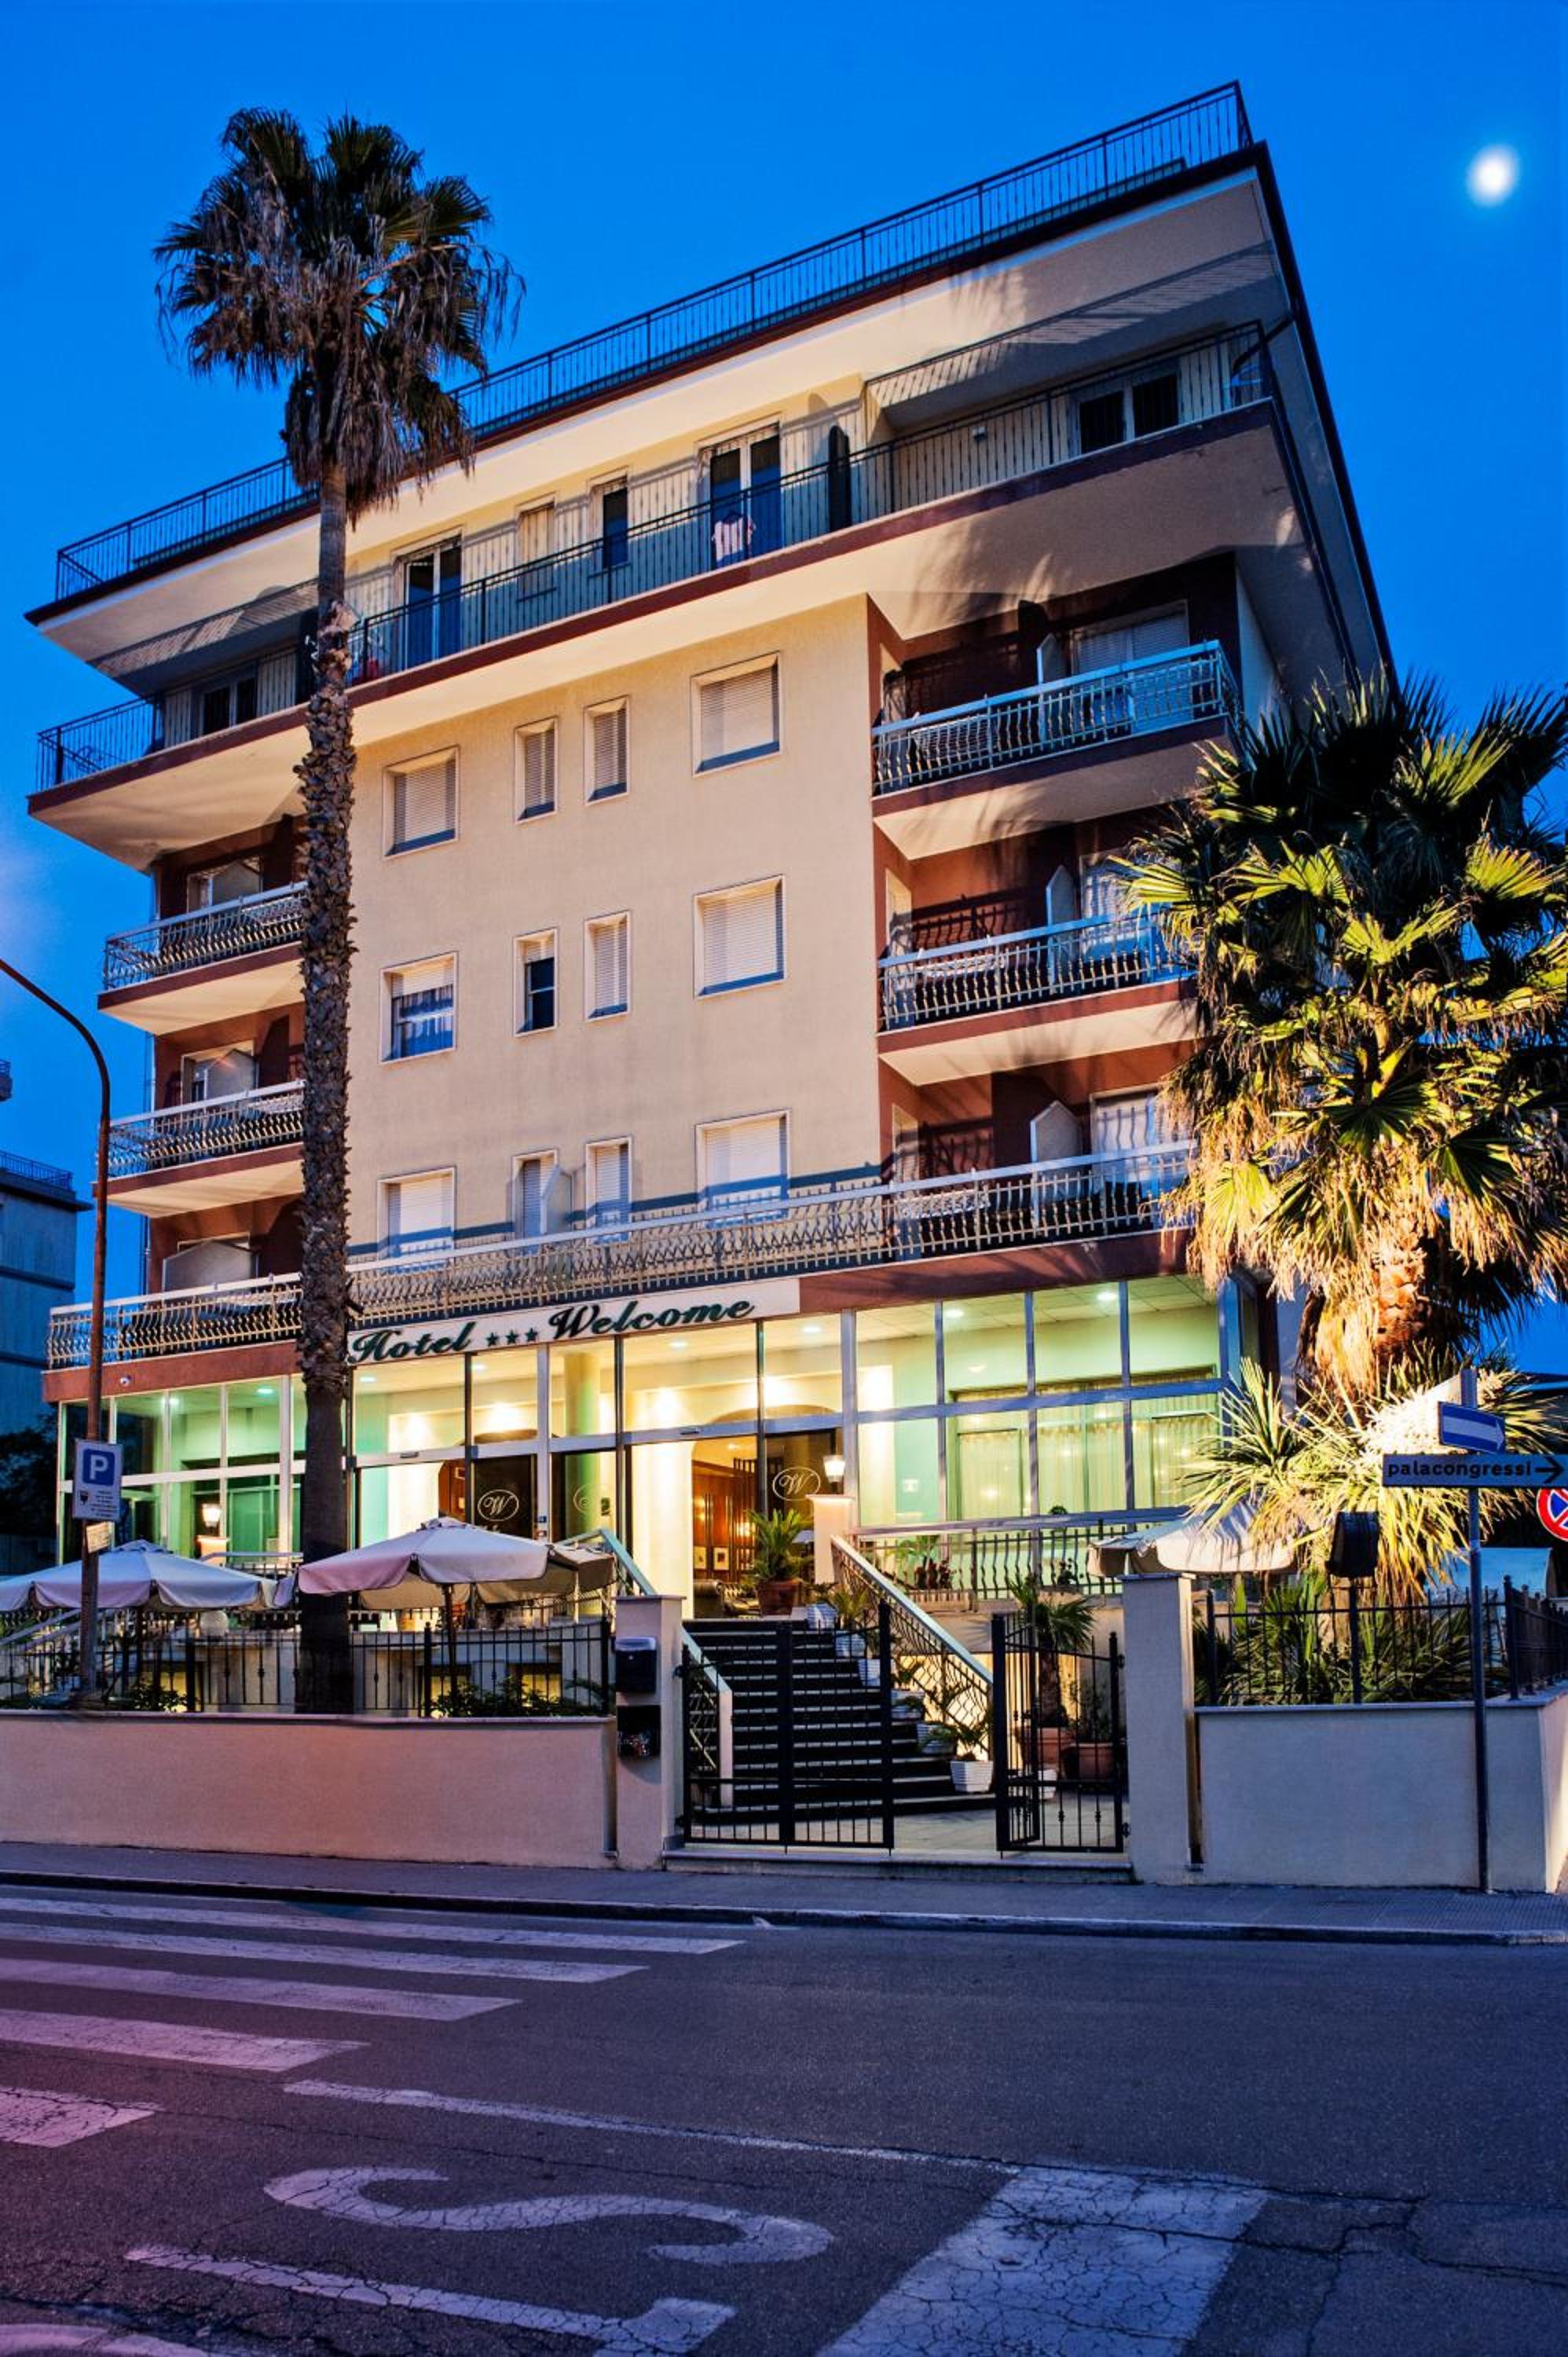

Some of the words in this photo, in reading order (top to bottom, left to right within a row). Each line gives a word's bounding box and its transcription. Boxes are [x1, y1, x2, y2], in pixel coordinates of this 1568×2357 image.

[346, 1321, 477, 1363] Hotel
[548, 1299, 755, 1340] Welcome
[90, 1454, 108, 1480] P
[1388, 1461, 1531, 1479] palacongressi
